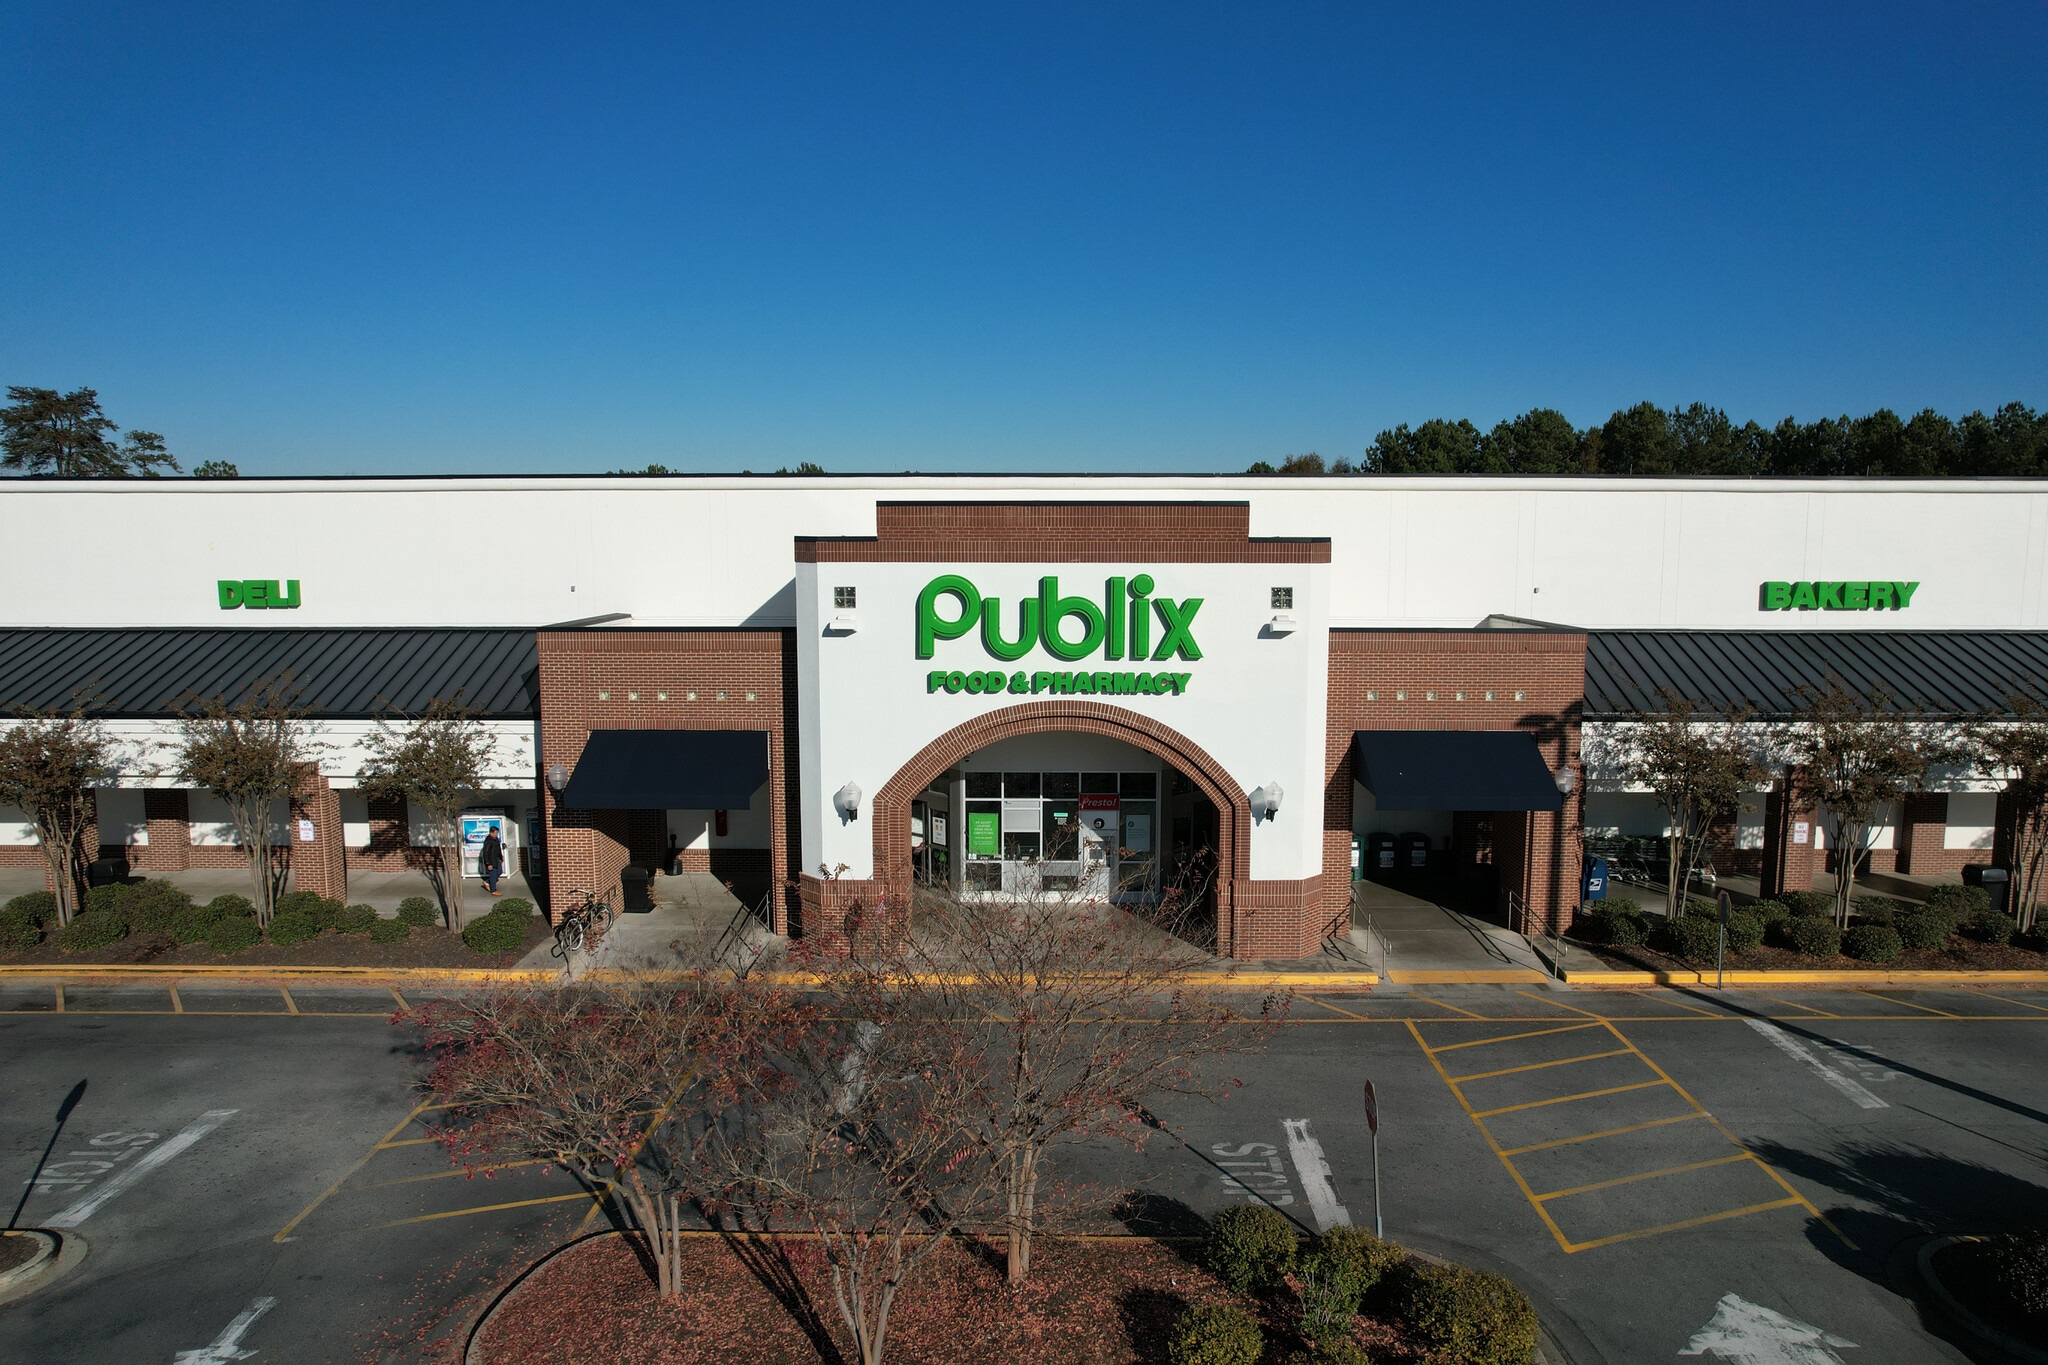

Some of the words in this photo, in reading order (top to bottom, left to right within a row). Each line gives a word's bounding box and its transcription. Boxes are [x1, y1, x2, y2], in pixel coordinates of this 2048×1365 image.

[218, 580, 301, 609] DELI
[1760, 581, 1920, 610] BAKERY
[916, 574, 1204, 661] Publix
[928, 671, 1007, 694] FOOD
[1008, 671, 1031, 694] &
[1032, 671, 1191, 695] PHARMACY
[1083, 798, 1117, 806] Presto!
[23, 1131, 160, 1194] STOP
[1211, 1142, 1295, 1206] STOP
